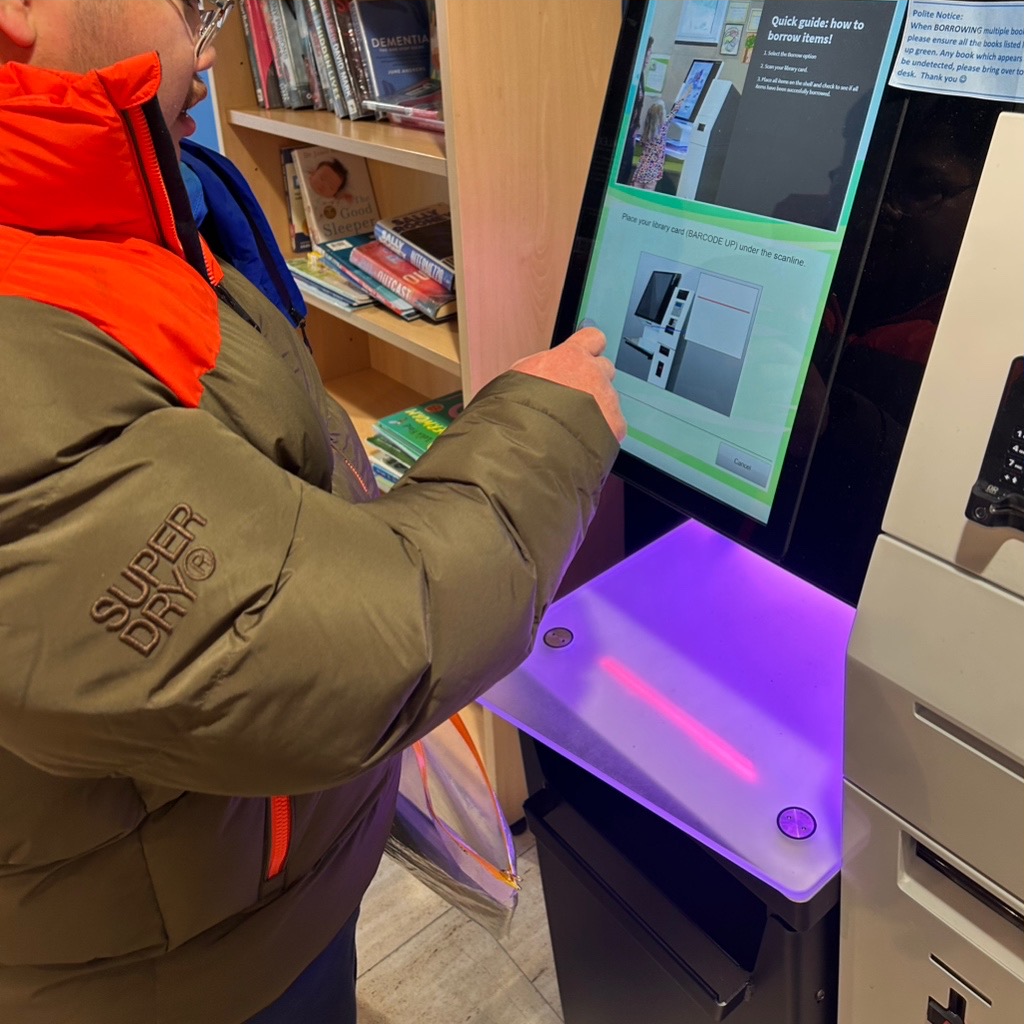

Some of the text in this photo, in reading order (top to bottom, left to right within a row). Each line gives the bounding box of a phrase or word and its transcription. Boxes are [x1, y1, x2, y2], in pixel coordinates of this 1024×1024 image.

[772, 15, 864, 30] Quick guide: how to
[370, 35, 430, 48] DEMENTIA
[768, 30, 833, 44] borrow items!
[622, 212, 637, 223] Place
[652, 220, 670, 232] library
[671, 226, 685, 235] card
[686, 229, 723, 245] (BARCODE
[724, 238, 738, 249] UP)
[739, 244, 759, 254] under
[761, 248, 772, 258] the
[377, 271, 413, 302] OUTCAST
[90, 503, 208, 633] SUPER
